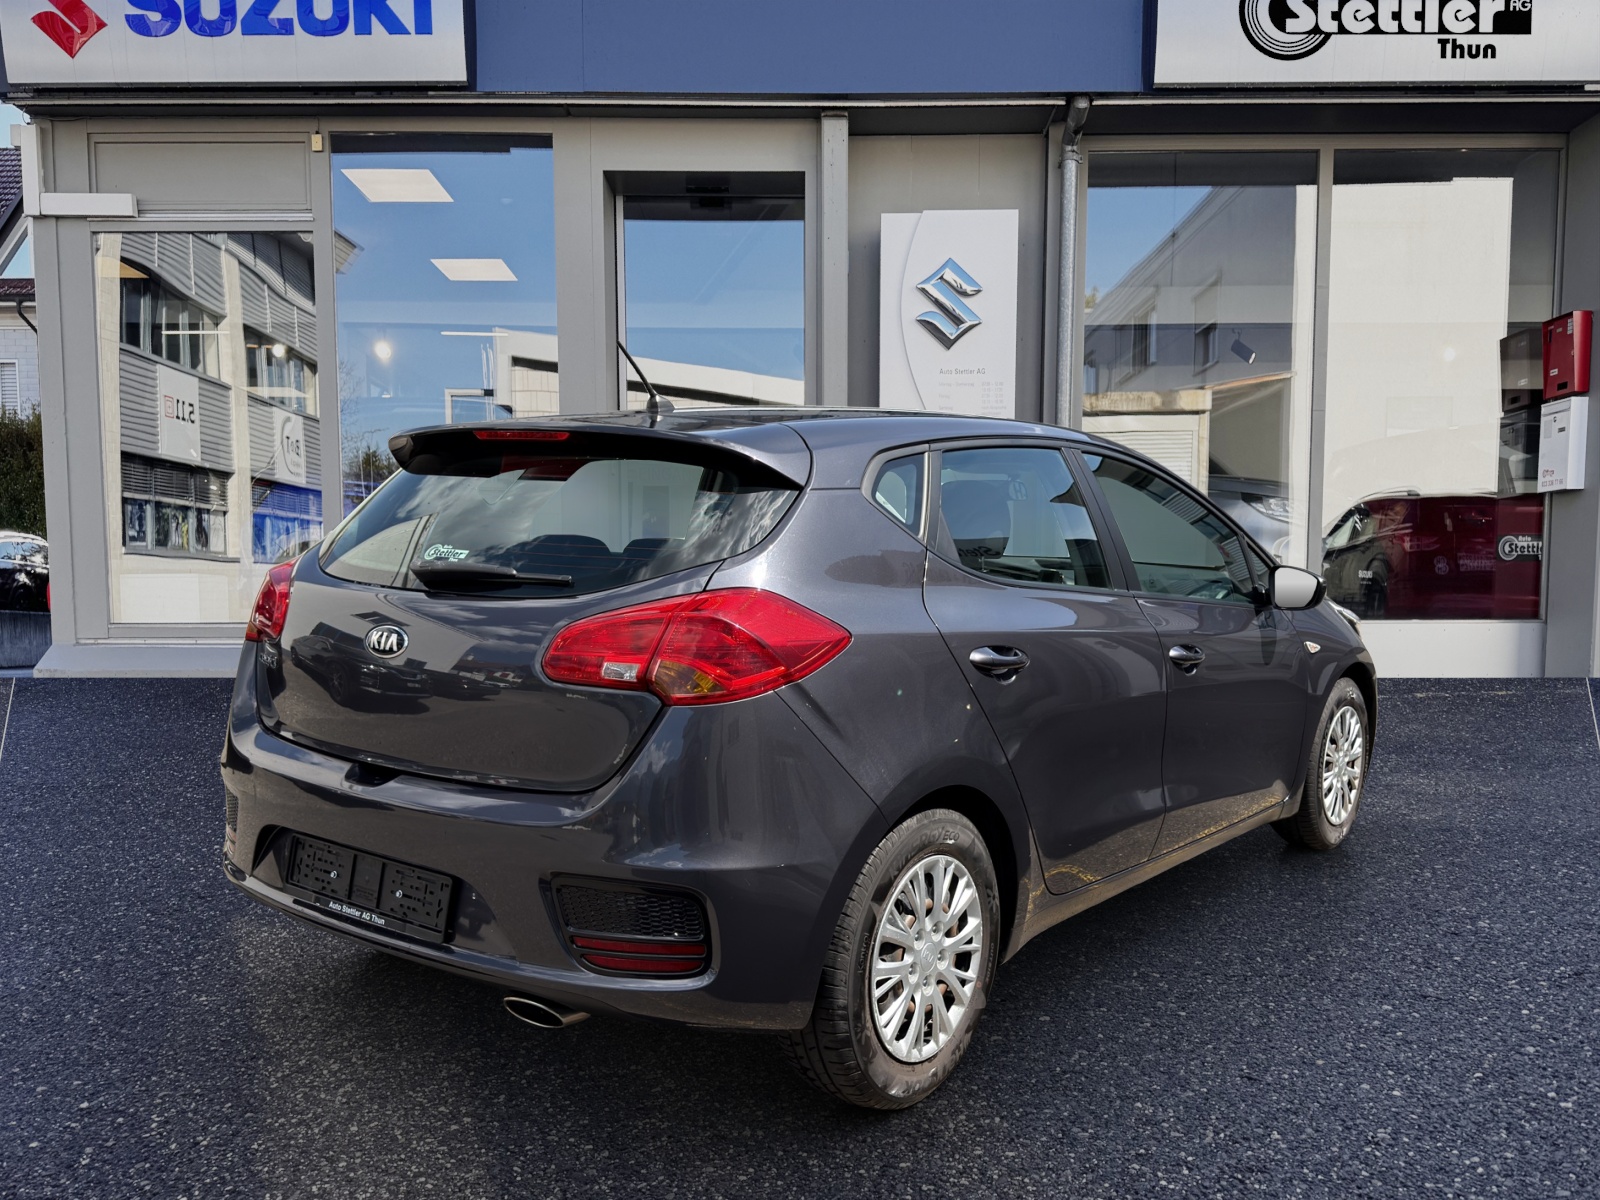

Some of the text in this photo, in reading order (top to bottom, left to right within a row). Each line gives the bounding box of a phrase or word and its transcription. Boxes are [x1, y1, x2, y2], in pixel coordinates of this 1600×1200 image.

[1286, 0, 1505, 34] Stettler
[1437, 38, 1497, 59] Thun
[431, 549, 464, 558] Stettler
[370, 631, 398, 651] KIA
[943, 829, 960, 842] ECO
[329, 901, 385, 925] Auto Stettler AG Thun
